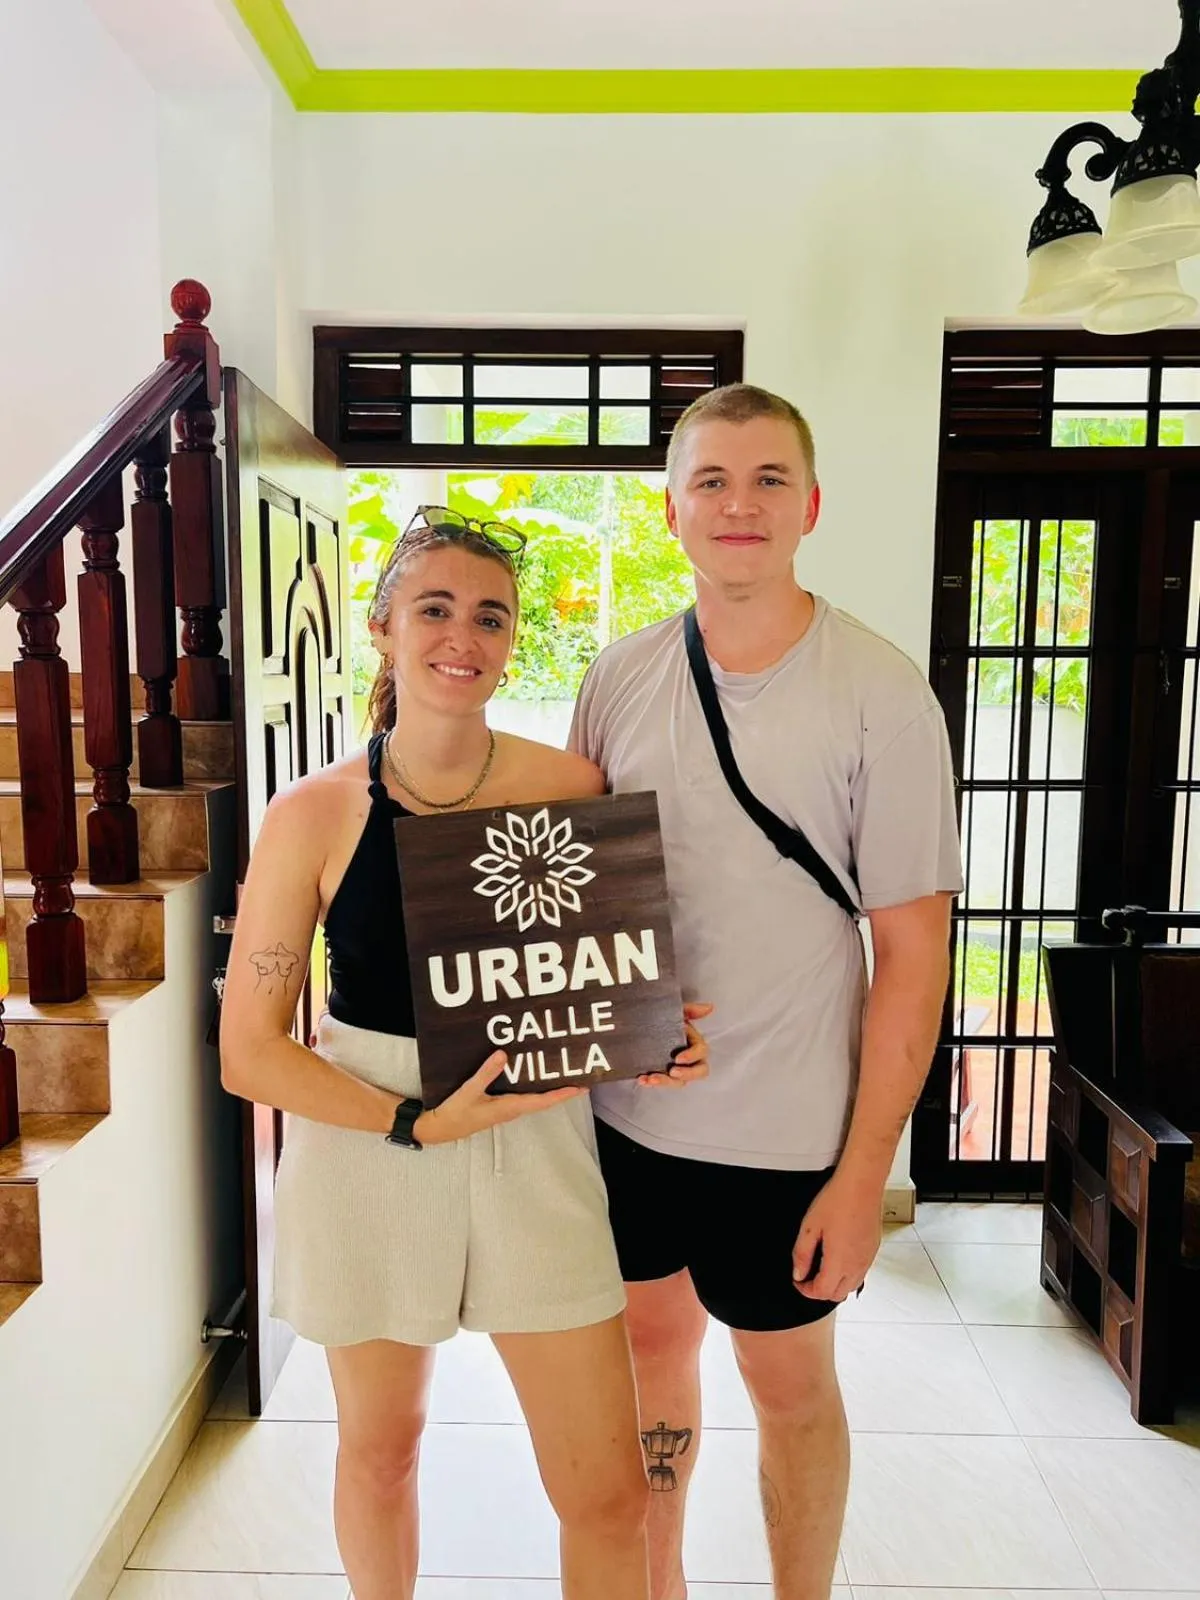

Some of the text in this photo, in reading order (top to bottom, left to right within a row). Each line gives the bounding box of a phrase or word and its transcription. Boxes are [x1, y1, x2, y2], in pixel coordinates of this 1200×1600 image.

[428, 929, 659, 1008] URBAN
[486, 1001, 615, 1046] GALLE
[503, 1043, 612, 1084] VILLA
